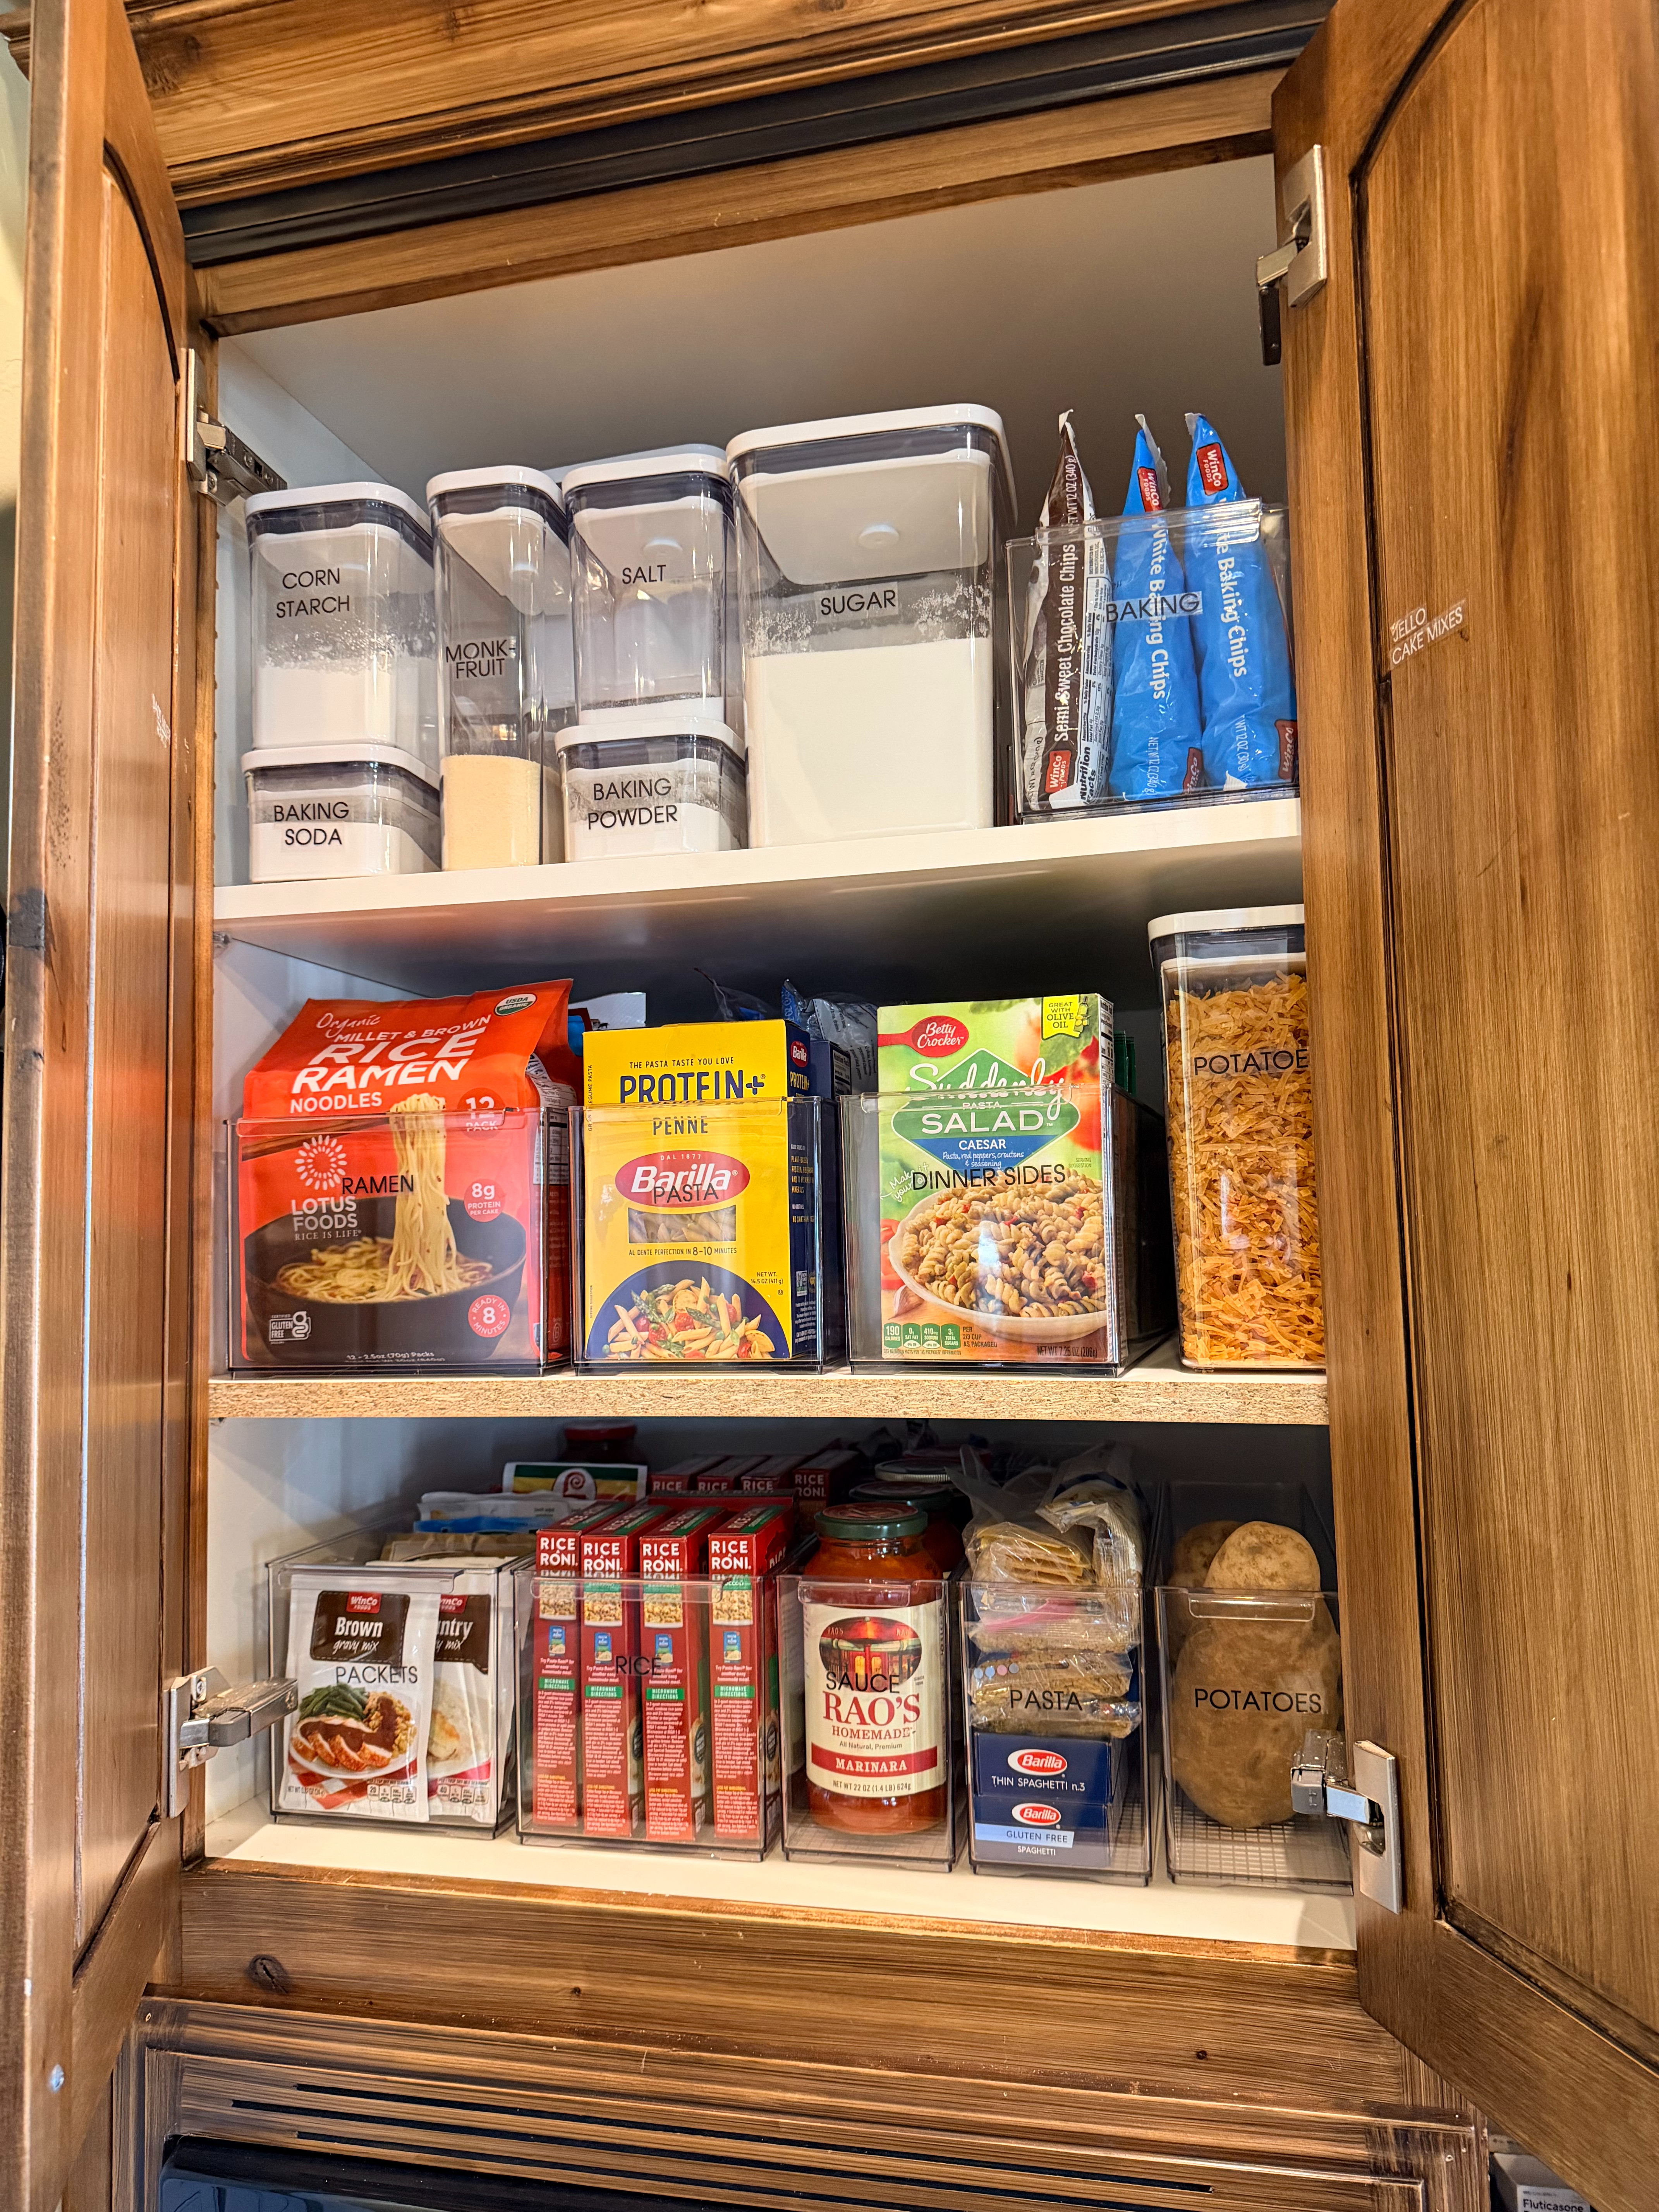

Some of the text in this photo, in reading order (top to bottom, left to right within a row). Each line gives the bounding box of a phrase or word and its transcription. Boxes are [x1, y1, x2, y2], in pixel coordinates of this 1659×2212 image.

[1065, 455, 1077, 464] g)
[1207, 449, 1221, 487] WinCo
[1065, 464, 1077, 481] (340
[1203, 459, 1213, 483] FOODS
[1066, 481, 1077, 493] OZ
[1143, 479, 1151, 502] FOODS
[1147, 473, 1159, 506] WinCo
[1067, 502, 1077, 515] WT
[1060, 544, 1076, 581] Chips
[282, 567, 341, 591] CORN
[622, 564, 666, 585] SALT
[1218, 556, 1240, 623] Baking
[276, 594, 350, 618] STARCH
[820, 589, 896, 616] SUGAR
[1106, 593, 1199, 622] BAKING
[1058, 585, 1075, 653] Chocolate
[1393, 608, 1426, 642] JELLO
[1392, 606, 1462, 664] CAKE MIXES
[445, 639, 515, 663] MONK-
[1228, 624, 1249, 677] Chips
[455, 658, 505, 679] FRUIT
[1149, 649, 1168, 699] Chips
[1049, 756, 1062, 788] WinCo
[1079, 747, 1091, 800] Nutrition
[592, 777, 672, 801] BAKING
[1086, 769, 1096, 803] Facts
[273, 801, 349, 823] BAKING
[587, 804, 678, 830] POWDER
[285, 828, 342, 846] SODA
[498, 1001, 530, 1012] ORGANIC
[505, 996, 529, 1005] USDA
[316, 1012, 381, 1039] Organic
[1046, 1013, 1074, 1022] OLIVE
[1053, 1020, 1068, 1029] OIL
[333, 1014, 492, 1043] MILLET & BROWN
[926, 1022, 956, 1037] Betty
[308, 1027, 487, 1066] RICE
[917, 1034, 961, 1048] Crocker
[645, 1060, 668, 1068] PASTA
[672, 1059, 694, 1067] TASTE
[697, 1058, 713, 1066] YOU
[715, 1056, 734, 1065] LOVE
[793, 1046, 807, 1062] Barilla
[1194, 1048, 1309, 1075] POTATOE
[291, 1058, 470, 1094] RAMEN
[620, 1069, 765, 1103] PROTEIN+
[904, 1057, 1065, 1121] Suddenly
[290, 1092, 383, 1114] NOODLES
[465, 1096, 495, 1120] 12
[962, 1101, 1002, 1110] PASTA
[465, 1121, 499, 1132] PACK
[653, 1116, 708, 1136] PENNE
[922, 1110, 1044, 1134] SALAD
[958, 1139, 1007, 1150] CAESAR
[943, 1152, 961, 1160] Pasta,
[972, 1151, 997, 1161] peppers,
[971, 1159, 1002, 1169] seasoning
[342, 1175, 414, 1195] RAMEN
[631, 1163, 730, 1193] Barilla
[889, 1162, 929, 1190] Make it
[912, 1164, 1066, 1190] DINNER SIDES
[471, 1183, 496, 1200] 8g
[653, 1183, 719, 1204] PASTA
[291, 1196, 357, 1216] LOTUS
[467, 1201, 501, 1210] PROTEIN
[293, 1212, 358, 1232] FOODS
[294, 1229, 319, 1241] RICE
[323, 1230, 333, 1240] IS
[693, 1246, 713, 1256] 8-10
[472, 1298, 506, 1313] READY IN
[483, 1307, 496, 1324] 8
[271, 1330, 284, 1338] FREE
[272, 1321, 293, 1329] GLUTEN
[474, 1320, 506, 1335] MINUTES
[886, 1326, 900, 1336] 190
[1037, 1346, 1098, 1358] NET WT 7.25 OZ (206g)
[743, 1480, 773, 1491] RICE
[795, 1474, 824, 1485] RICE
[540, 1537, 575, 1550] RICE
[584, 1542, 620, 1556] RICE
[642, 1543, 679, 1556] RICE
[711, 1540, 748, 1554] RICE
[350, 1596, 378, 1606] WinCo
[335, 1617, 383, 1638] Brown
[333, 1640, 380, 1655] gravy mix
[444, 1639, 461, 1650] mix
[336, 1666, 418, 1683] PACKETS
[616, 1656, 662, 1676] RICE
[826, 1672, 900, 1694] SAUCE
[823, 1691, 921, 1726] RAO'S
[1009, 1689, 1083, 1711] PASTA
[1195, 1688, 1322, 1714] POTATOES
[832, 1725, 910, 1740] HOMEMADE
[848, 1742, 873, 1750] Natural,
[836, 1757, 907, 1772] MARINARA
[1022, 1754, 1063, 1769] Barilla
[844, 1781, 852, 1789] WT
[854, 1783, 861, 1791] 22
[872, 1784, 883, 1792] (1.4
[885, 1784, 895, 1792] LB)
[897, 1783, 911, 1791] 624g
[991, 1775, 1085, 1792] THIN SPAGHETTI n.3
[1023, 1808, 1057, 1821] Barilla
[1006, 1830, 1068, 1843] GLUTEN FREE
[1017, 1845, 1056, 1856] SPAGHETTI
[1523, 2198, 1584, 2212] Fluticasone
